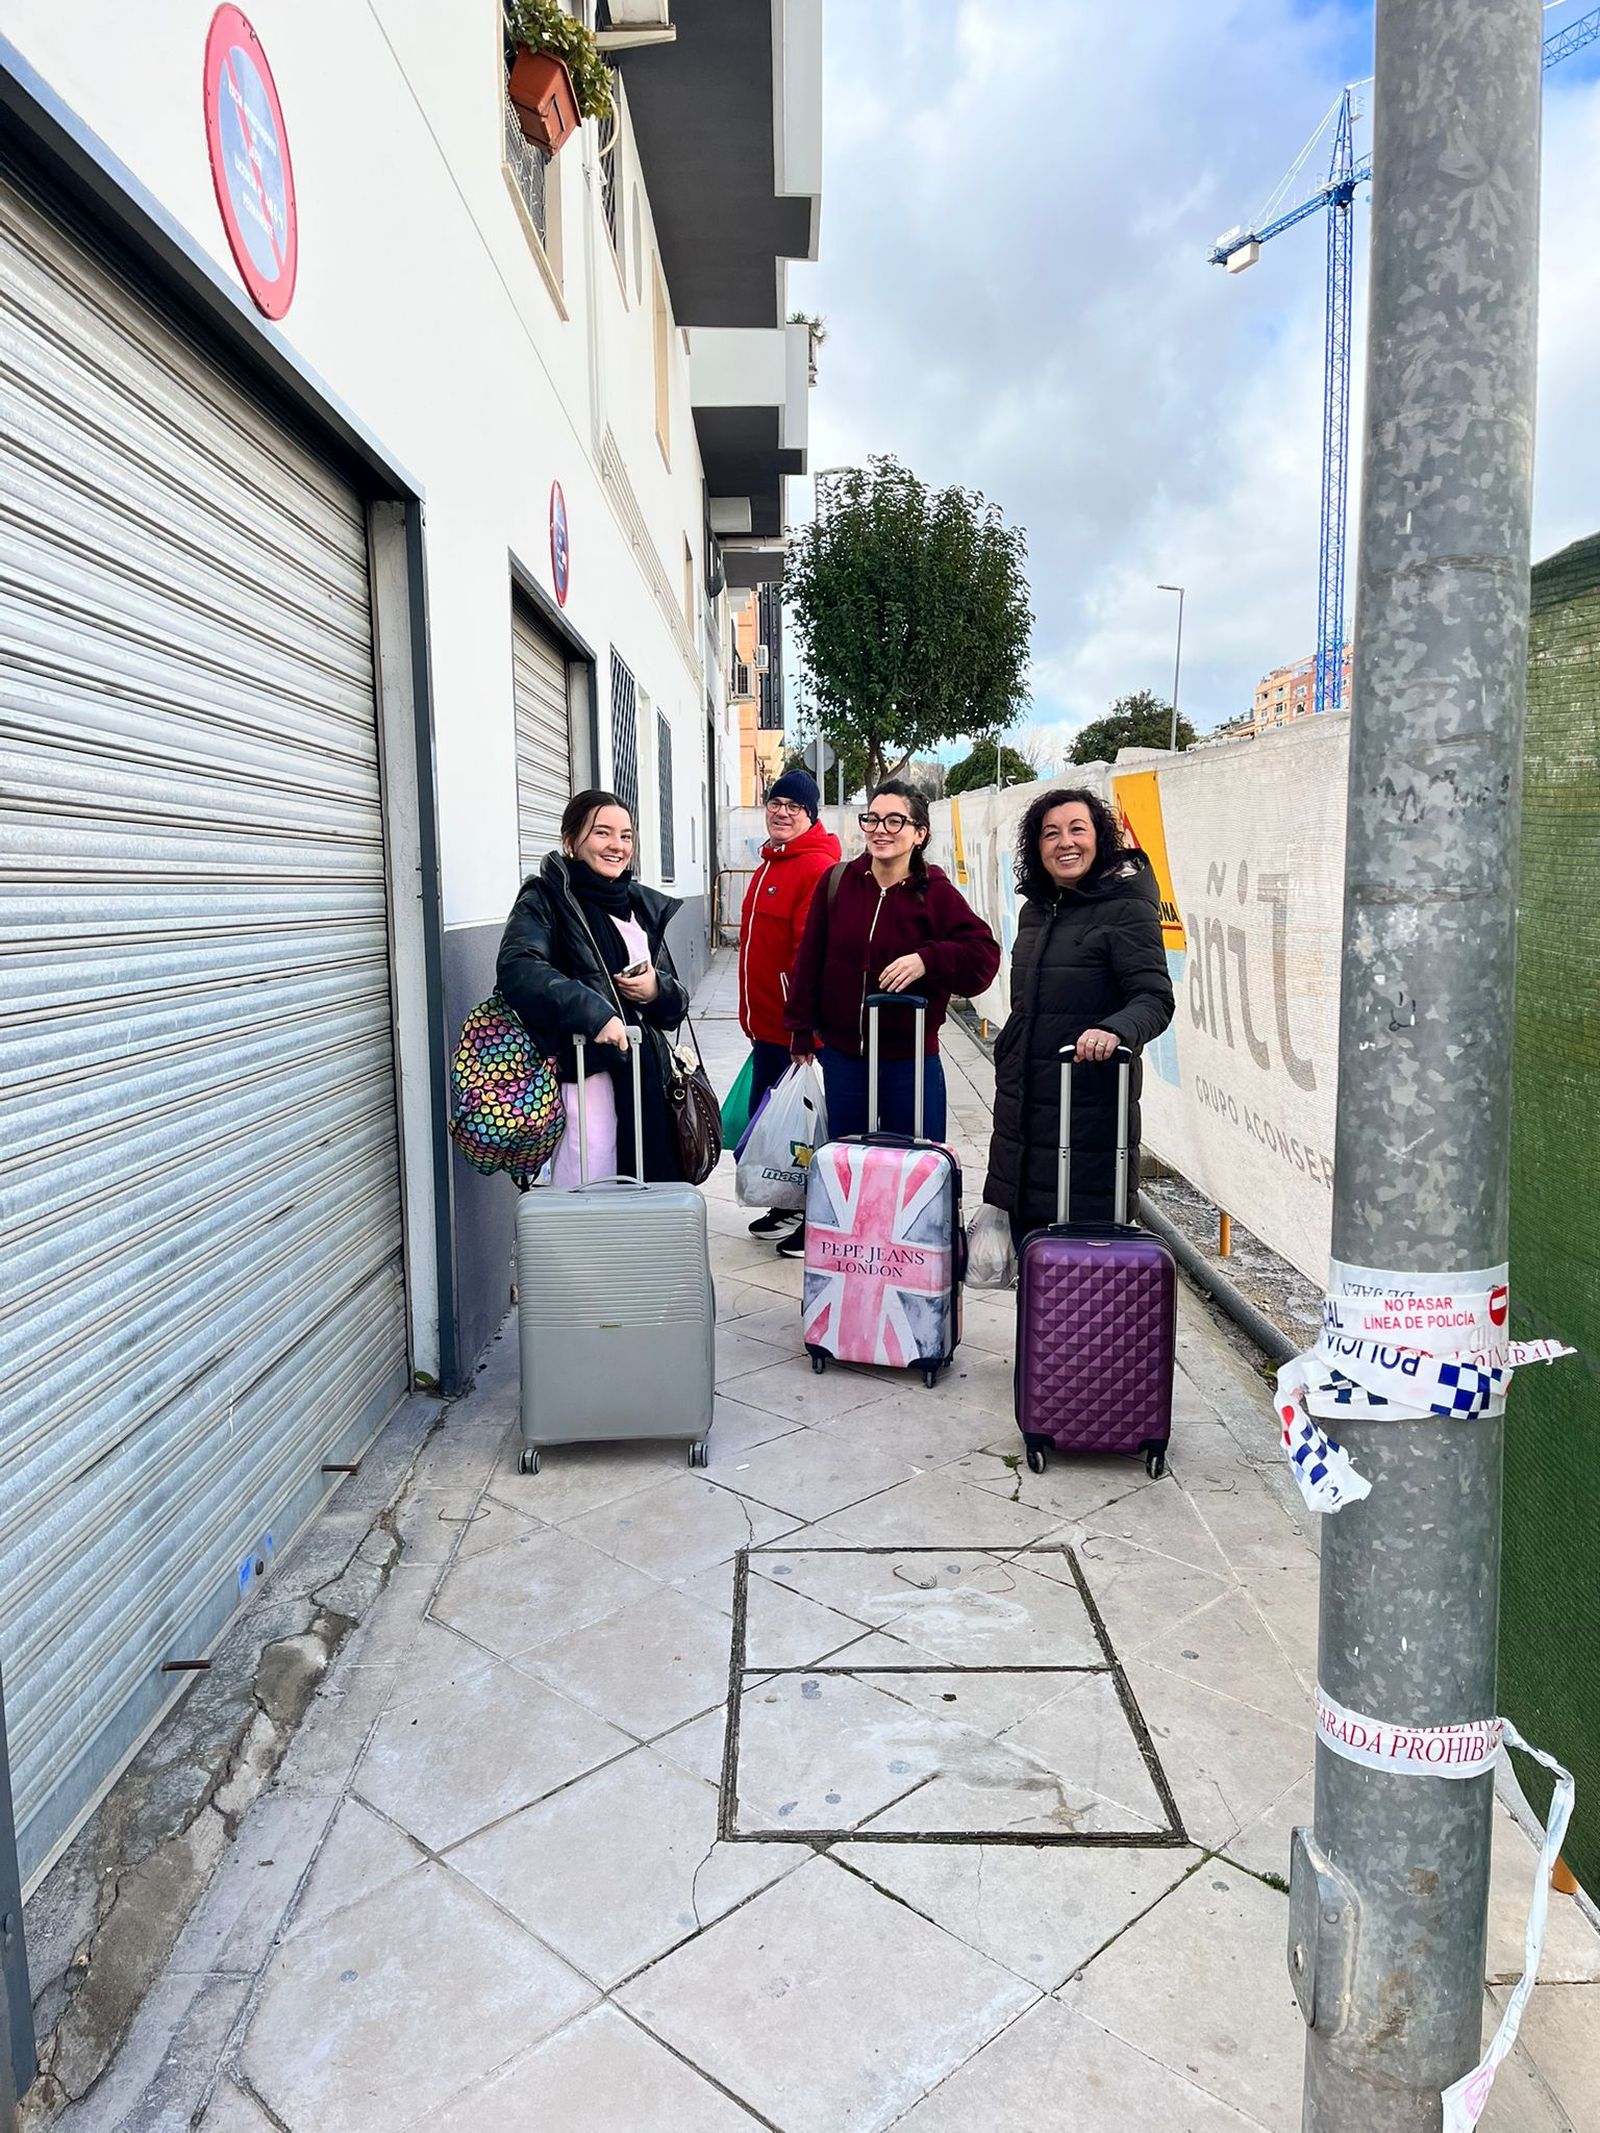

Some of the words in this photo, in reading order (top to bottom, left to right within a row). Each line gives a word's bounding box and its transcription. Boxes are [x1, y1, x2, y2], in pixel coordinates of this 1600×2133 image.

[1195, 1075, 1239, 1126] GRUPO
[762, 1167, 808, 1186] masy
[821, 1241, 864, 1259] PEPE
[865, 1246, 925, 1266] JEANS
[836, 1260, 903, 1278] LONDON
[1384, 1298, 1405, 1312] NO
[1407, 1297, 1453, 1311] PASAR
[1363, 1313, 1402, 1330] LÍNEA
[1404, 1315, 1424, 1329] DE
[1427, 1311, 1476, 1329] POLICÍA
